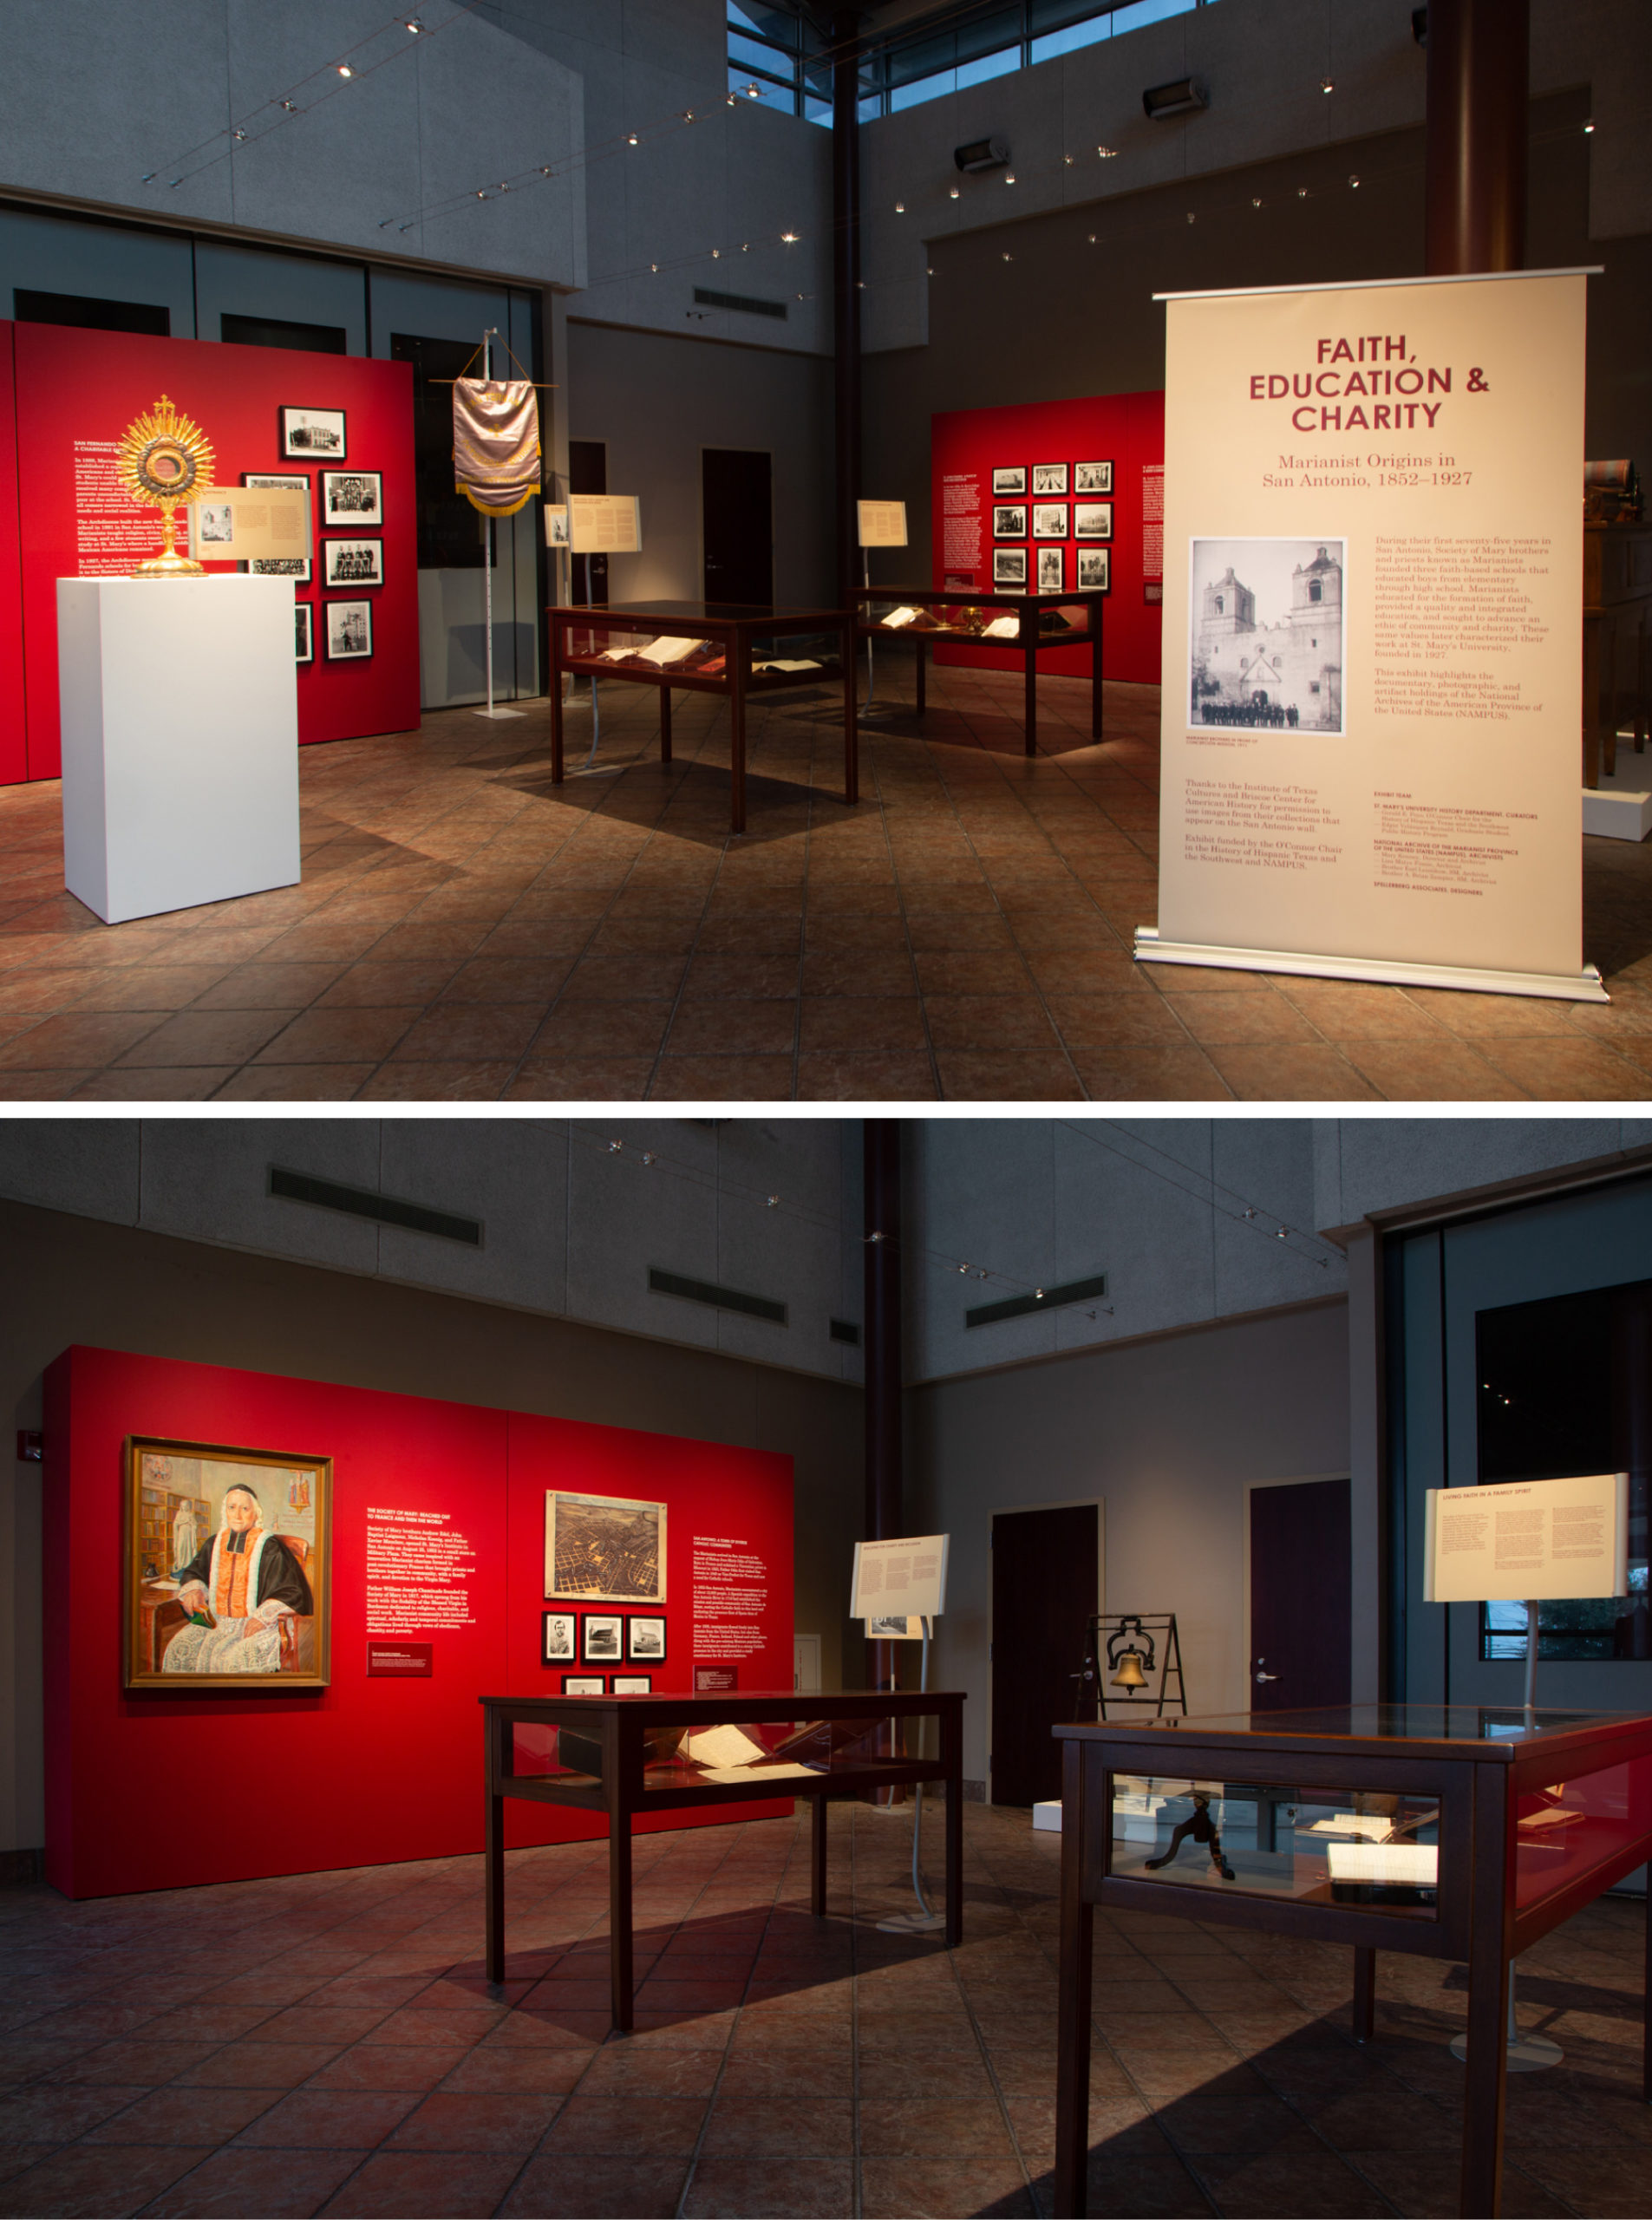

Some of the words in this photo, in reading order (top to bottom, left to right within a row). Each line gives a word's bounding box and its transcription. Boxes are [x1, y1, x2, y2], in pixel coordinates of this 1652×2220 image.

[1317, 335, 1417, 364] FAITH,
[1250, 367, 1452, 400] EDUCATION
[1466, 367, 1490, 393] &
[1292, 402, 1442, 432] CHARITY
[1279, 454, 1361, 468] Marianist
[1368, 453, 1433, 471] Origins
[1440, 452, 1455, 466] in
[1263, 473, 1294, 486] San
[1300, 473, 1370, 488] Antonio,
[1376, 537, 1407, 546] During
[1455, 537, 1511, 546] seventy-five
[1435, 546, 1467, 556] Society
[1482, 546, 1505, 556] Mary
[1394, 555, 1424, 565] priests
[1472, 556, 1523, 565] Marianists
[1417, 574, 1437, 584] boys
[1463, 575, 1516, 585] elementary
[1375, 584, 1410, 593] through
[1413, 584, 1433, 594] high
[1417, 593, 1429, 602] for
[1449, 594, 1493, 603] formation
[1375, 603, 1414, 612] provided
[1424, 604, 1455, 613] quality
[1479, 604, 1526, 614] integrated
[1443, 614, 1472, 624] sought
[1487, 614, 1525, 623] advance
[1375, 621, 1396, 630] ethic
[1409, 623, 1459, 633] community
[1521, 624, 1549, 633] These
[1455, 633, 1518, 642] characterized
[1427, 642, 1457, 651] Mary's
[1374, 650, 1410, 658] founded
[1374, 668, 1394, 676] This
[1430, 670, 1476, 681] highlights
[1374, 688, 1407, 696] artifact
[1409, 689, 1447, 699] holdings
[1479, 691, 1519, 701] National
[1375, 696, 1413, 706] Archives
[1444, 700, 1487, 708] American
[1491, 702, 1531, 711] Province
[1392, 707, 1422, 715] United
[1425, 708, 1453, 717] States
[1186, 780, 1216, 788] Thanks
[1244, 784, 1280, 793] Institute
[1185, 789, 1221, 798] Cultures
[1241, 793, 1271, 801] Briscoe
[1186, 798, 1224, 807] American
[1227, 801, 1257, 812] History
[1274, 806, 1320, 814] permission
[1201, 808, 1230, 819] images
[1276, 814, 1320, 824] collections
[1261, 822, 1295, 831] Antonio
